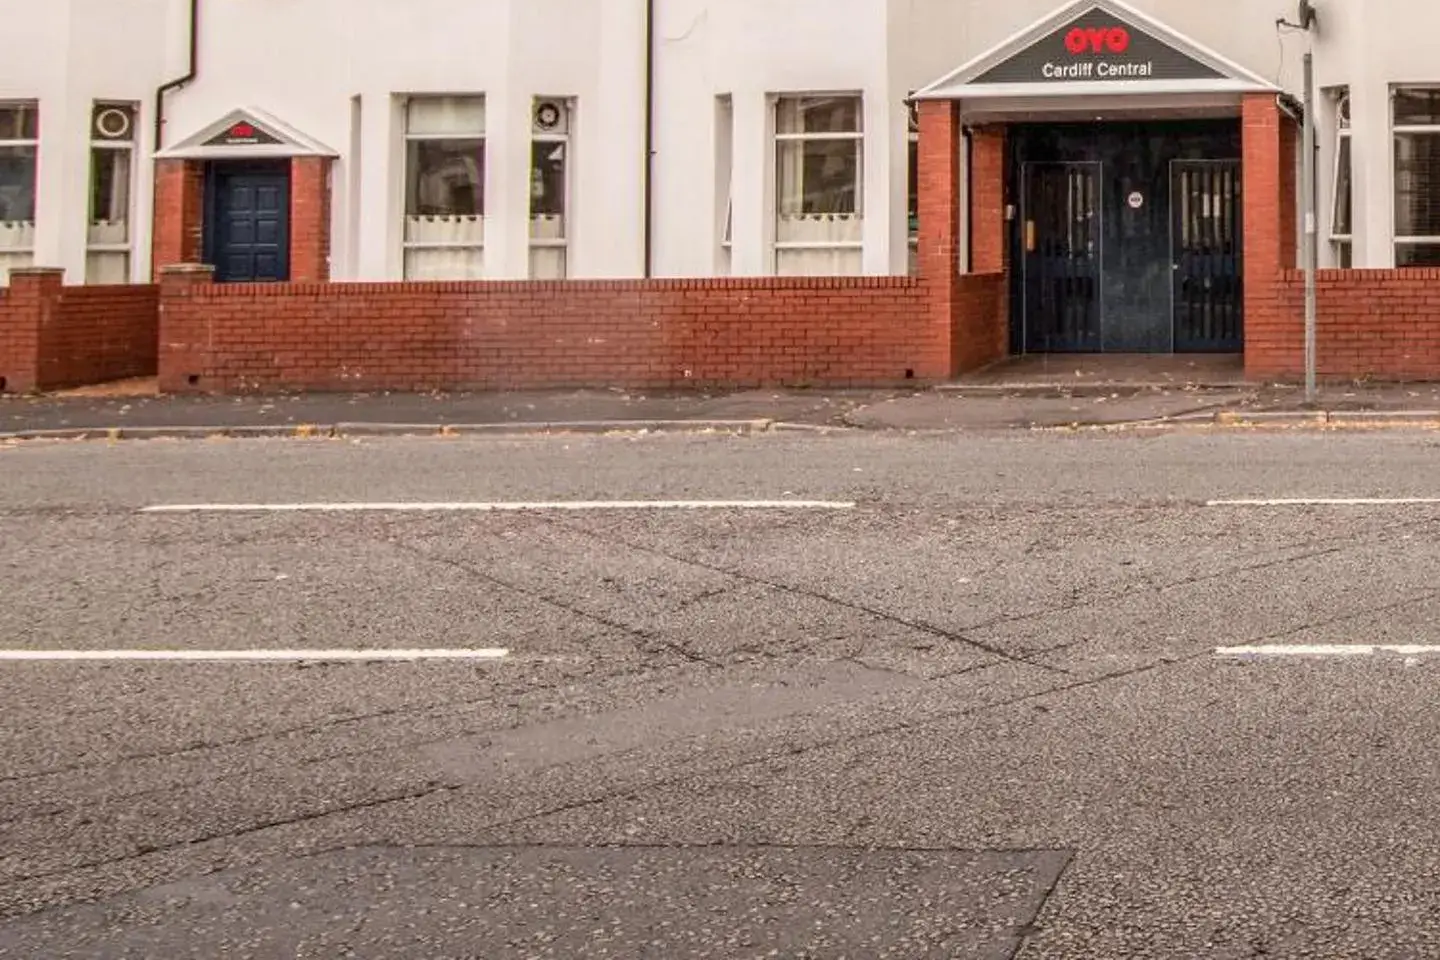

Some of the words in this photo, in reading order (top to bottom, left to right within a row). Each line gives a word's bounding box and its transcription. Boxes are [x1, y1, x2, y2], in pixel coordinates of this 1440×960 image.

[1064, 26, 1130, 54] OYO
[1042, 62, 1093, 77] Cardiff
[1097, 61, 1152, 76] Central
